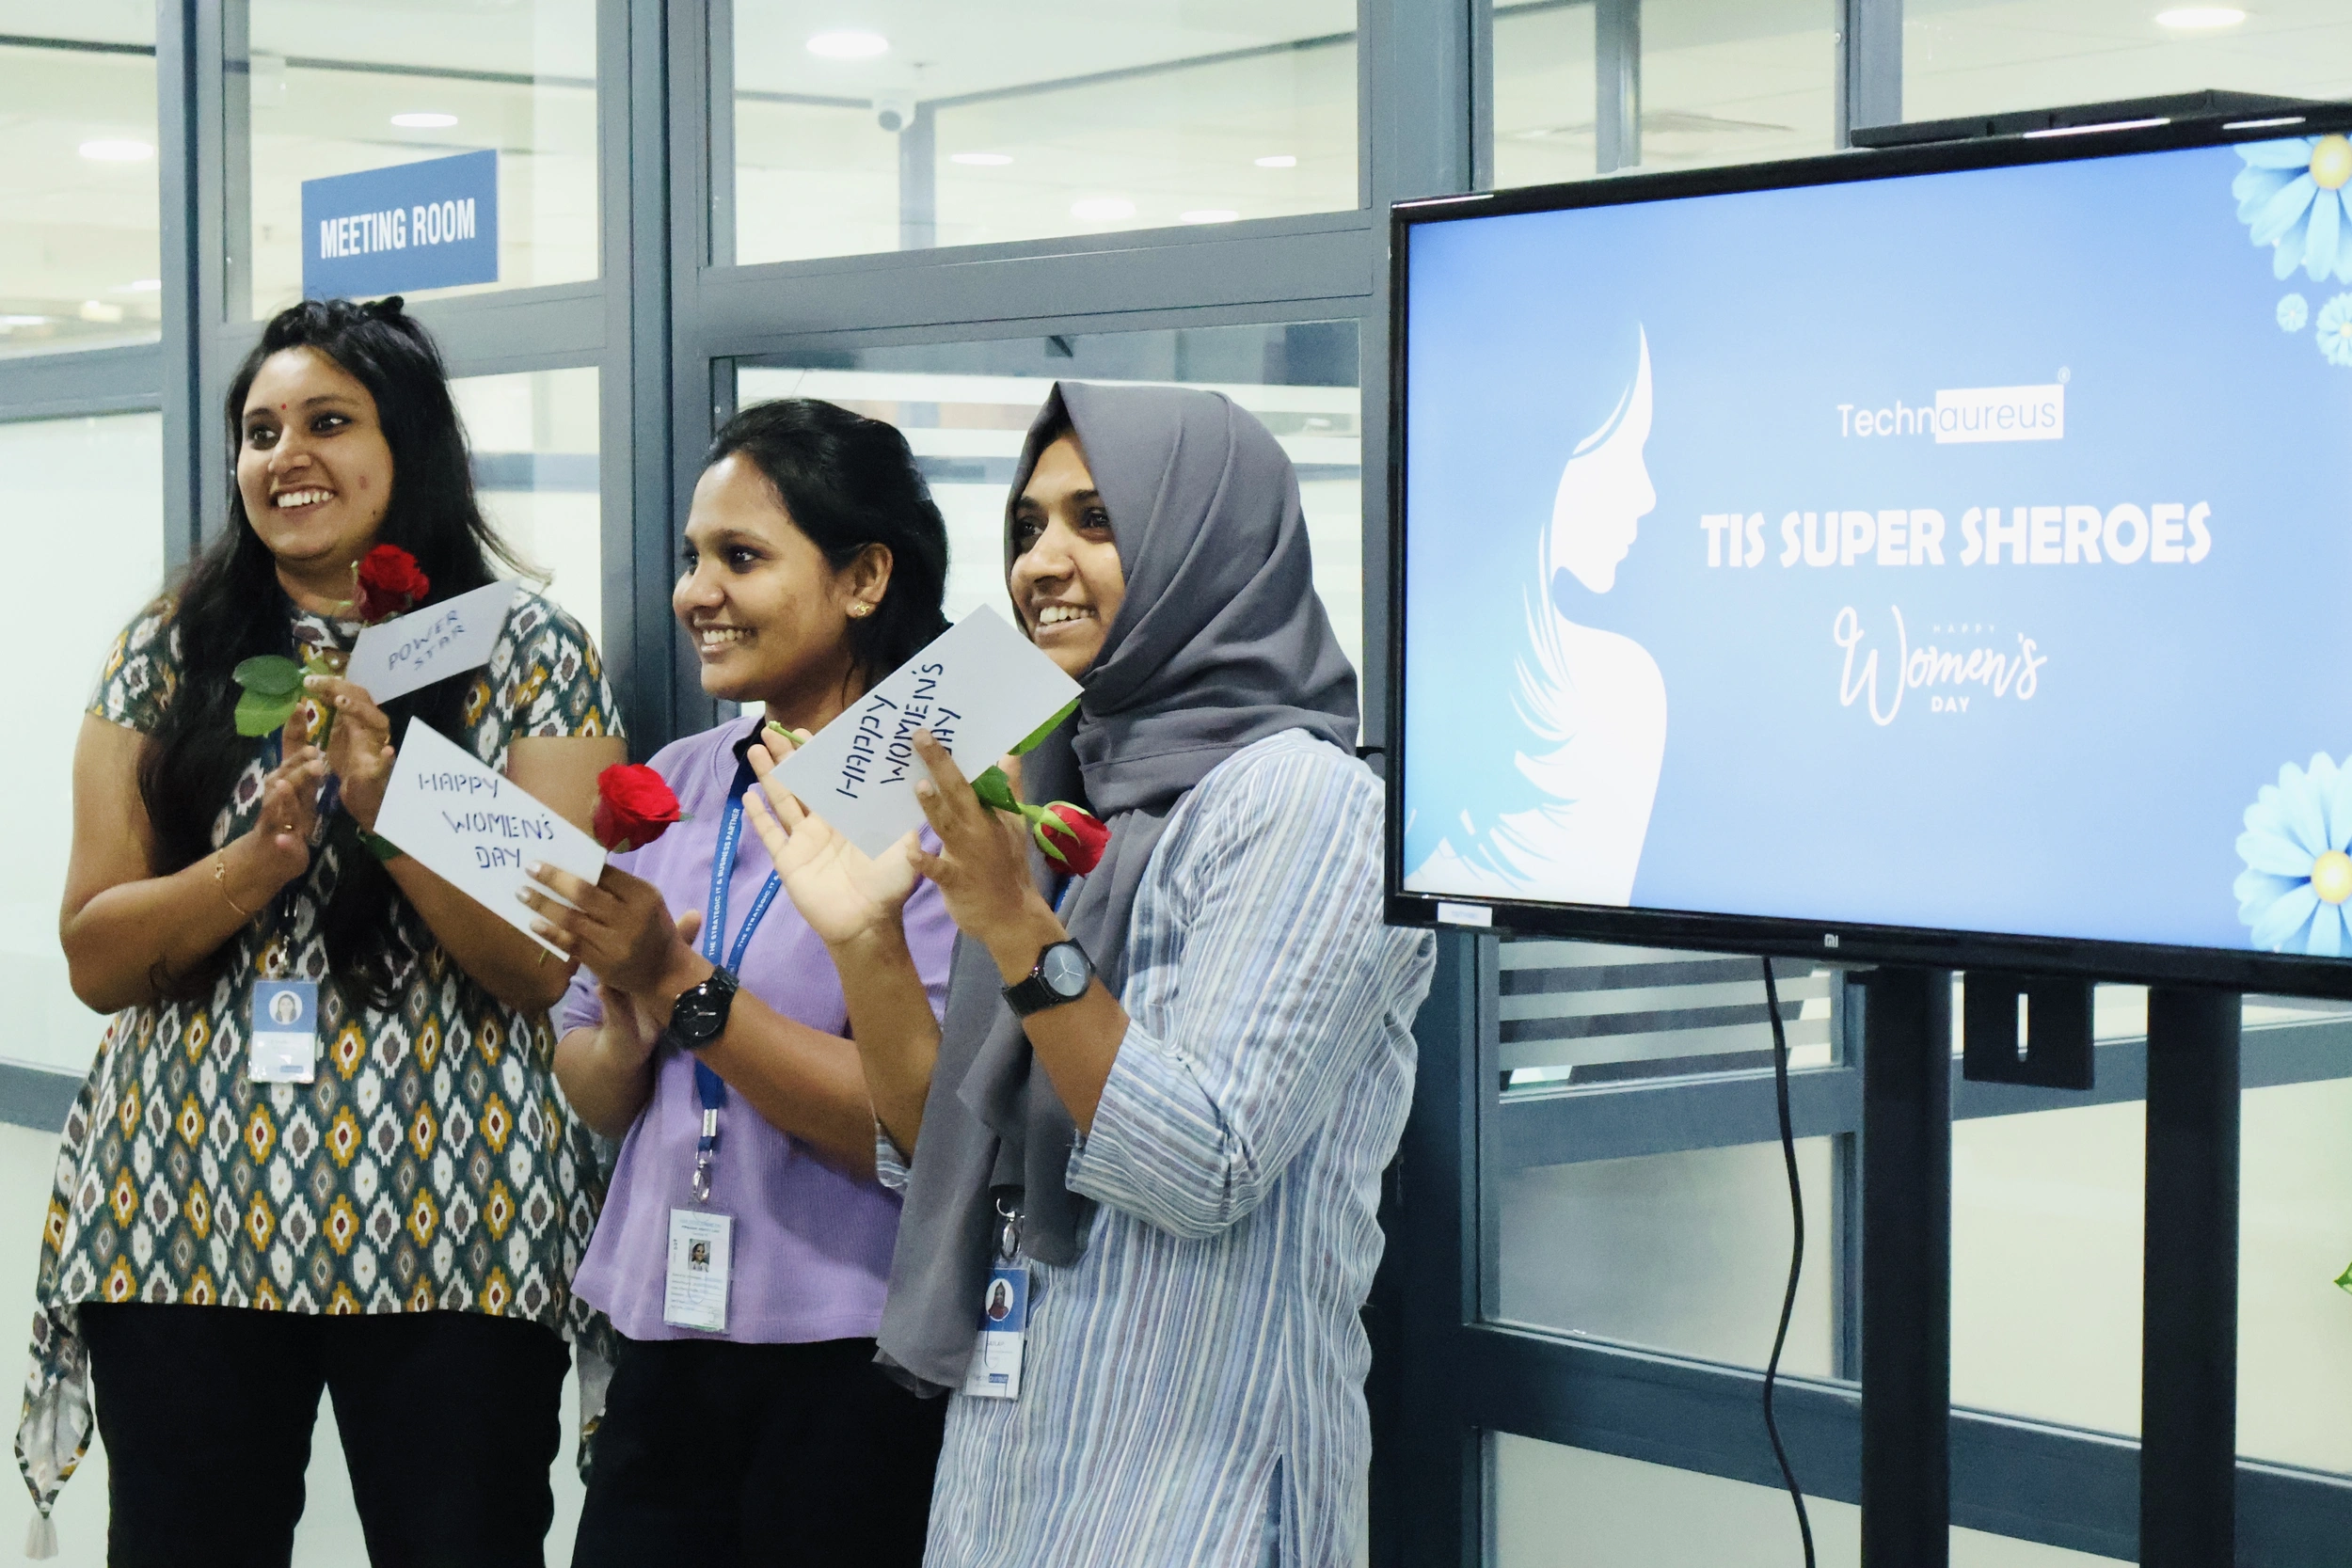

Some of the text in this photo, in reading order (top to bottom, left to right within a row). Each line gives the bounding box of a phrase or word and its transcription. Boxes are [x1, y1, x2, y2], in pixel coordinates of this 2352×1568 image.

[321, 198, 475, 260] MEETING ROOM
[1700, 500, 2212, 568] TIS SUPER SHEROES
[389, 610, 458, 671] POWER
[414, 625, 465, 672] STAR
[1933, 624, 1995, 633] HAPPY
[1834, 604, 2048, 726] Women's
[880, 662, 944, 784] WOMEN'S
[1931, 695, 1970, 713] DAY
[836, 694, 898, 800] HAPPY
[931, 707, 961, 756] AY
[419, 772, 499, 798] HAPPY
[441, 812, 554, 840] WOMEN'S
[724, 807, 741, 841] PARTNER
[475, 846, 520, 868] DAY
[717, 840, 731, 878] BUSINESS
[715, 886, 723, 895] IT
[709, 895, 722, 940] STRATEGIC
[737, 934, 748, 948] THE
[745, 889, 771, 933] STRATEGIC
[768, 880, 776, 890] IT
[707, 941, 717, 958] THE
